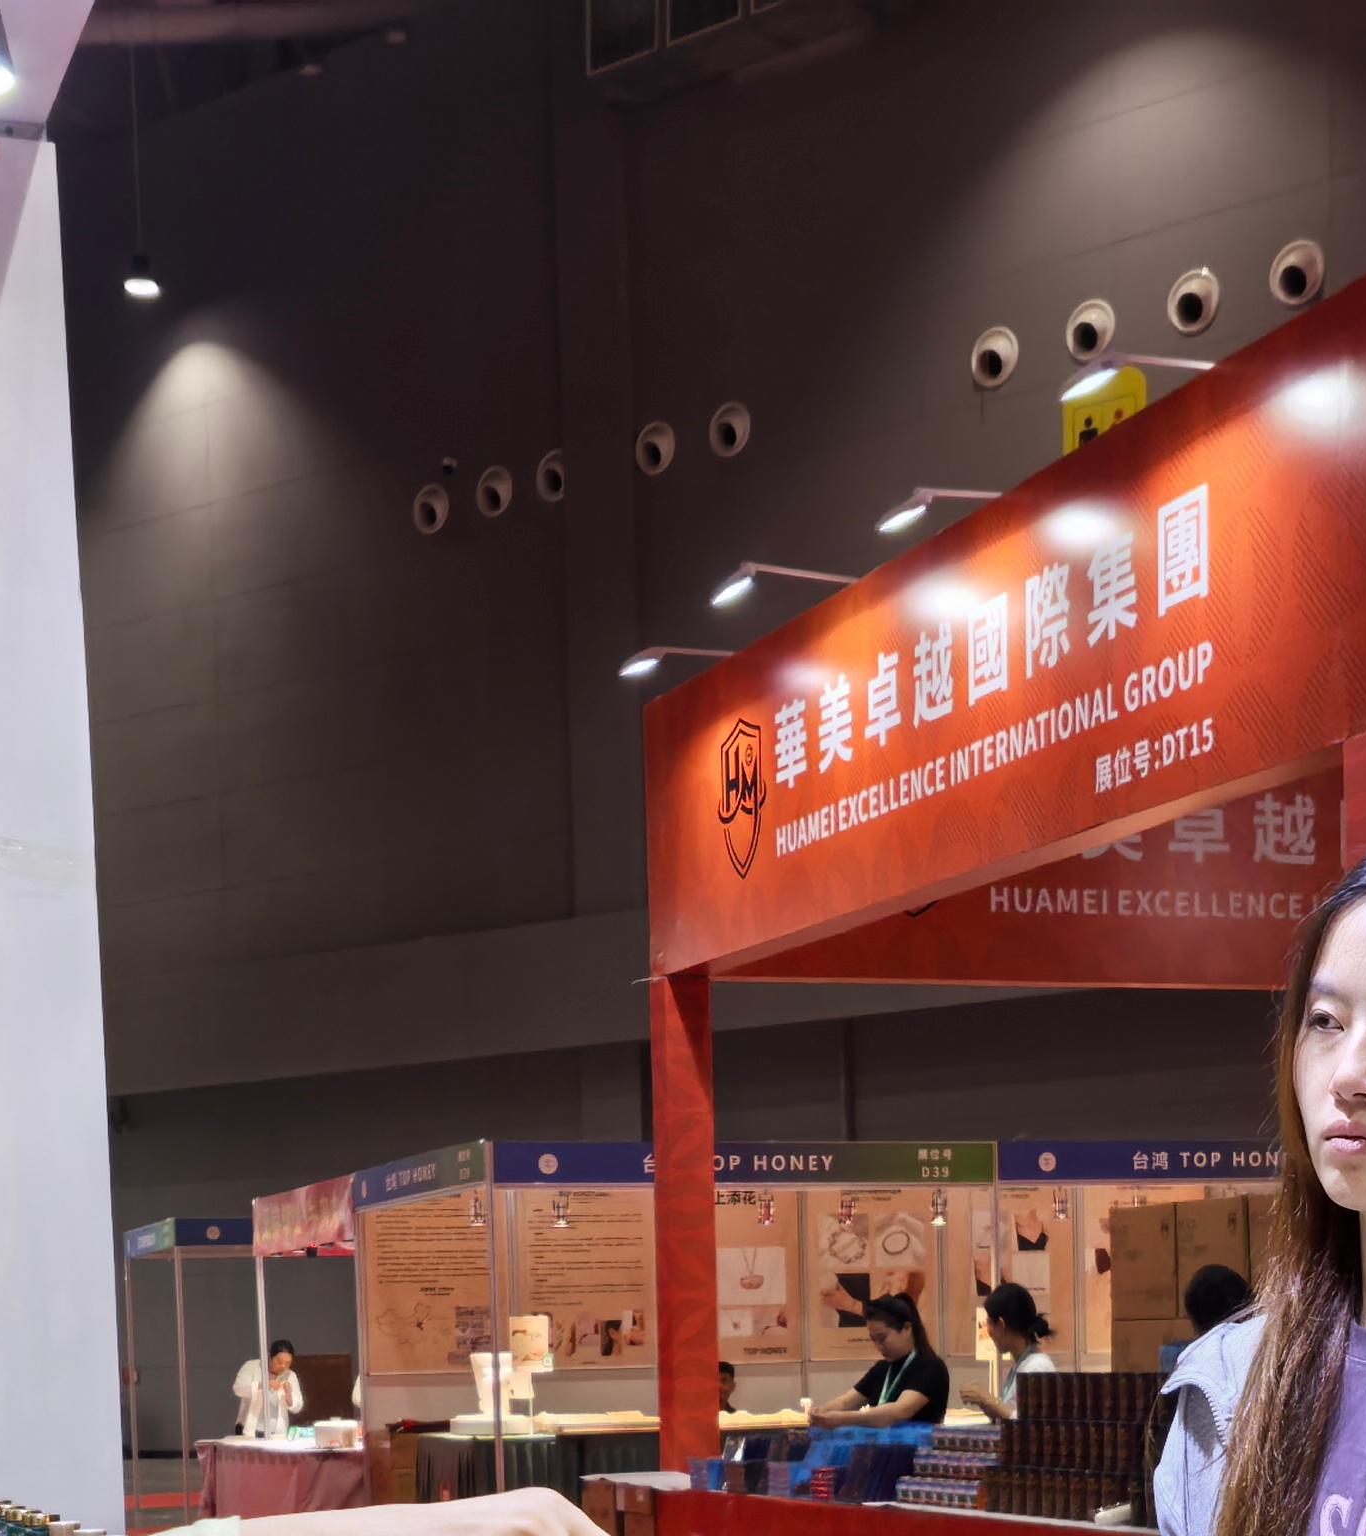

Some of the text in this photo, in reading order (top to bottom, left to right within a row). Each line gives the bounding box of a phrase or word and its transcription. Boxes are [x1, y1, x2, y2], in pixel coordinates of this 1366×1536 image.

[774, 483, 1209, 789] 華美卓越國際集團
[775, 641, 1214, 858] HUAMEI EXCELLENCE INTERNATIONAL GROUP
[990, 886, 1108, 915] HUAMEI
[1118, 889, 1303, 920] EXCELLENCE
[714, 1155, 741, 1171] OP
[753, 1155, 834, 1171] HONEY
[1180, 1152, 1221, 1168] TOP
[1232, 1151, 1280, 1168] HON
[921, 1167, 950, 1178] D39
